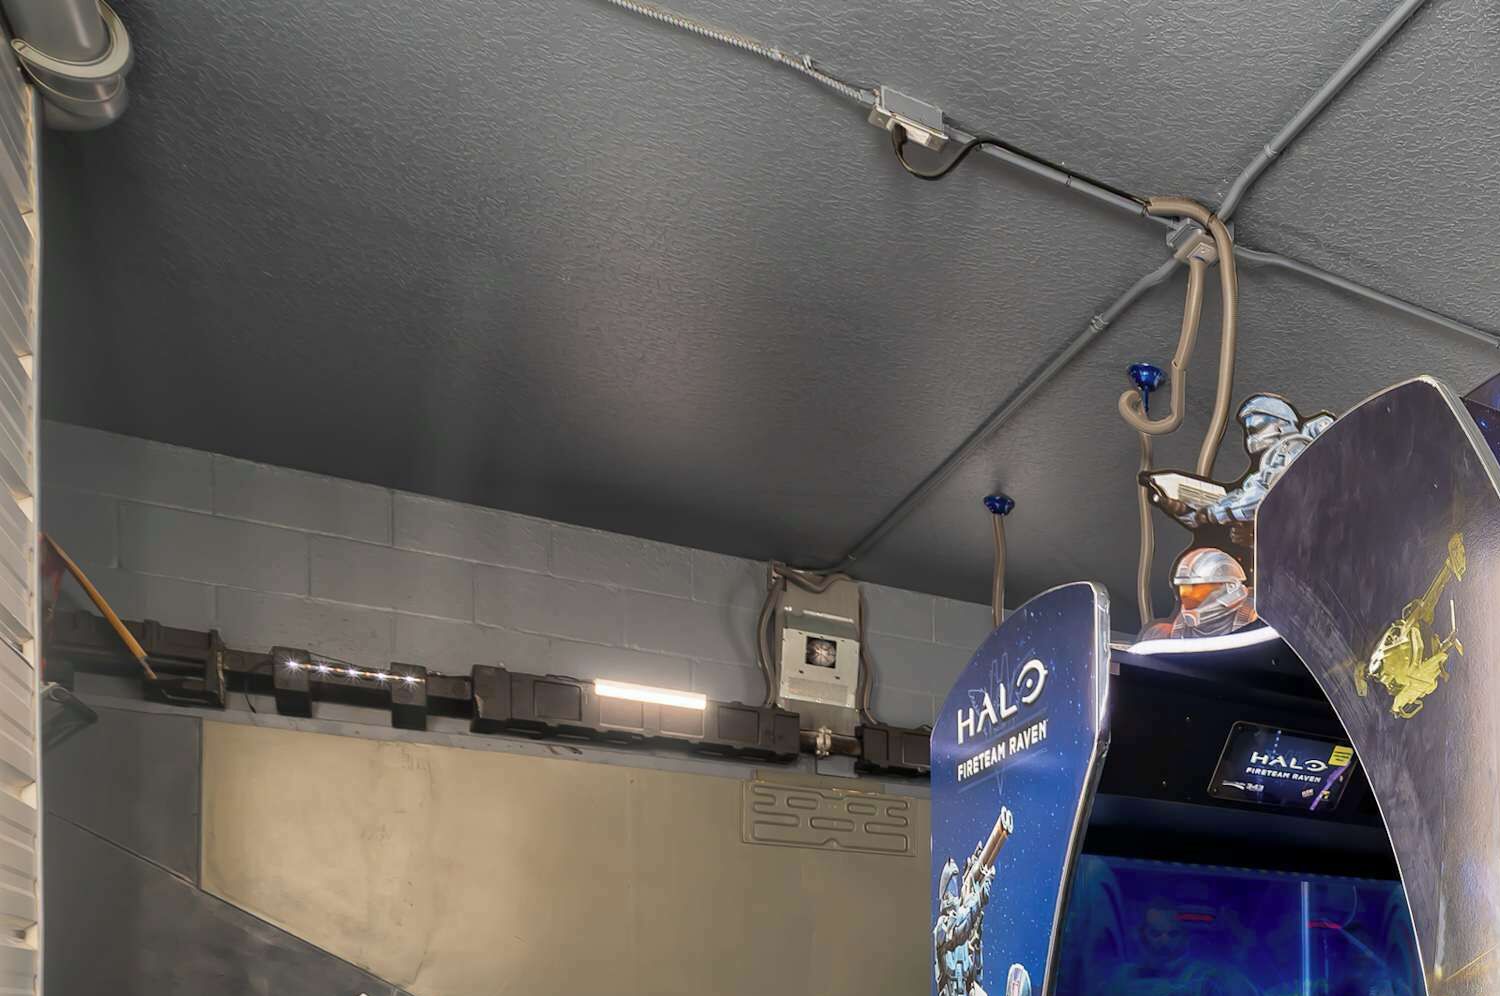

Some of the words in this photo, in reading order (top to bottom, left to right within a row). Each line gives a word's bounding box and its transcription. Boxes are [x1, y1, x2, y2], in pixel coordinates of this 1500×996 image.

[957, 659, 1048, 745] HALO
[957, 741, 1006, 782] FIRETEAM
[1009, 719, 1048, 756] RAVEN
[1250, 751, 1328, 772] HALO
[1245, 766, 1291, 779] FIRETEAM
[1292, 773, 1322, 783] RAVEN
